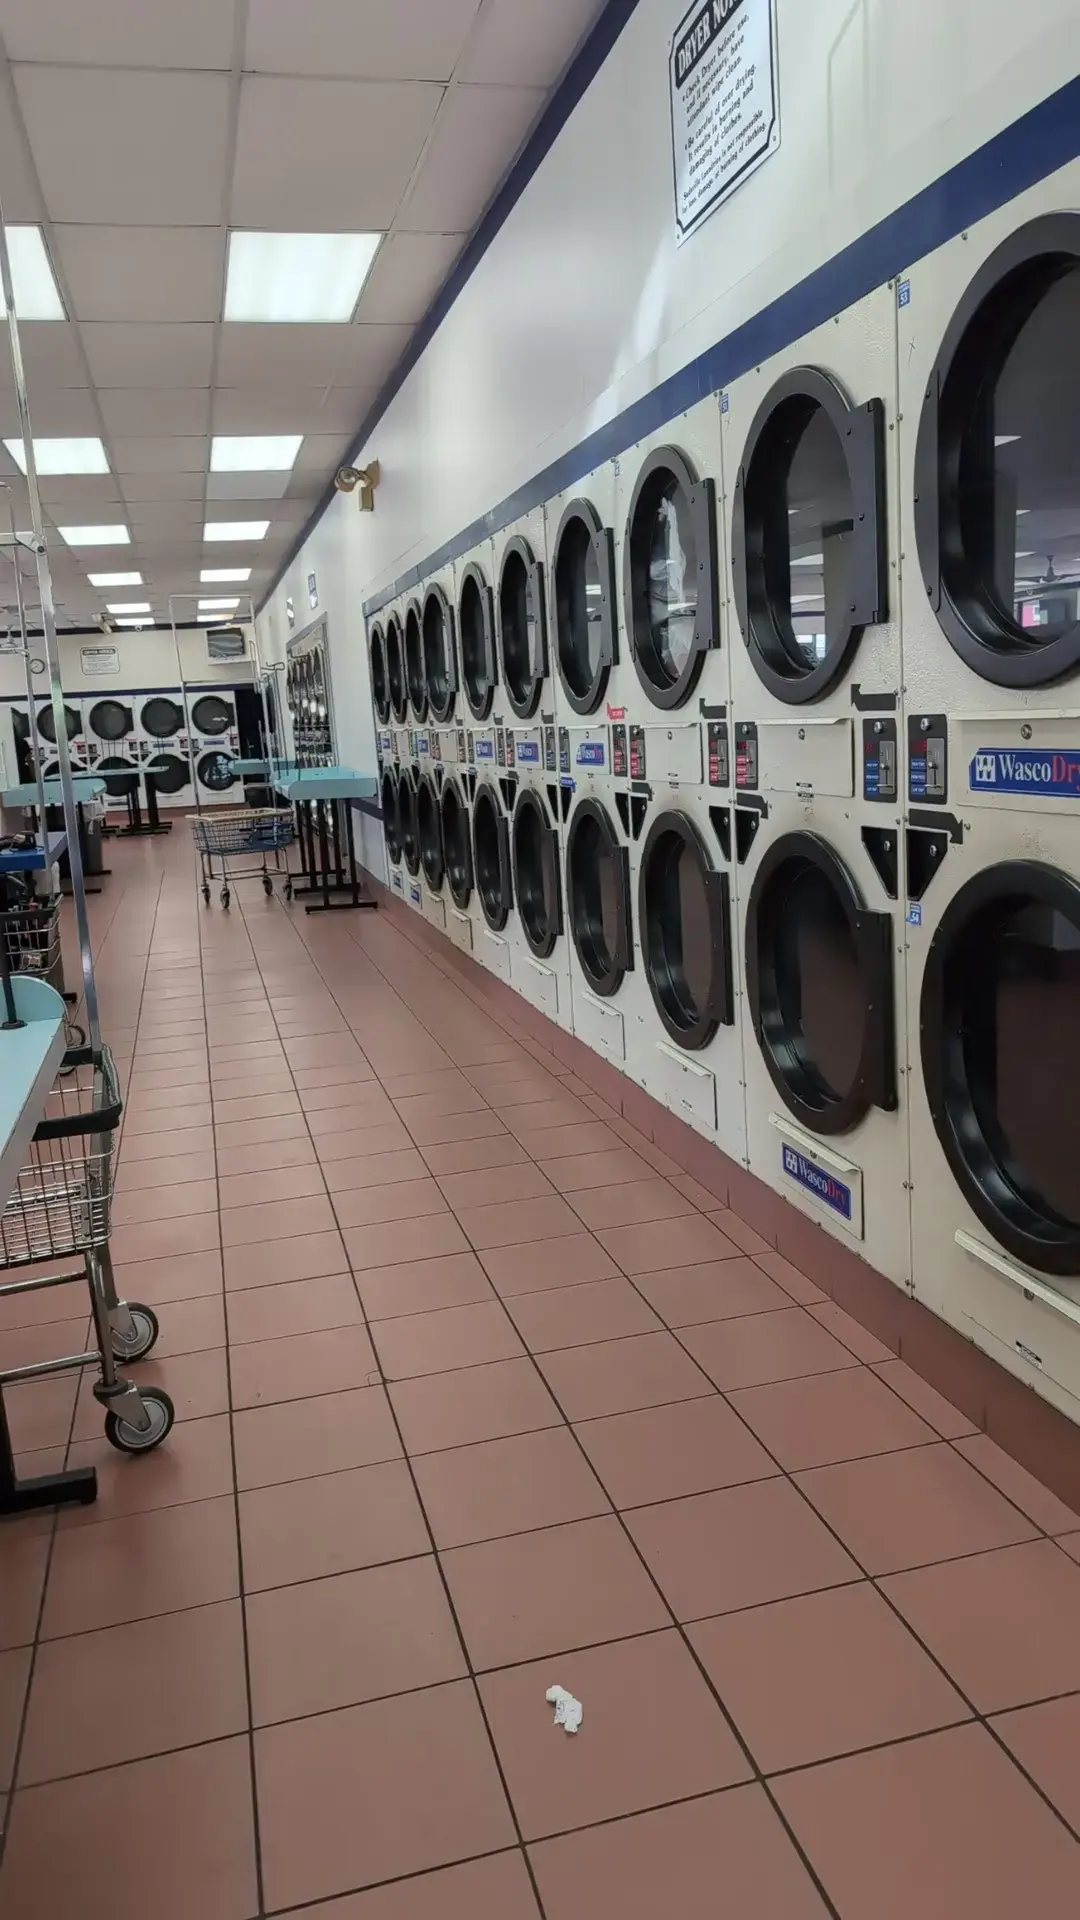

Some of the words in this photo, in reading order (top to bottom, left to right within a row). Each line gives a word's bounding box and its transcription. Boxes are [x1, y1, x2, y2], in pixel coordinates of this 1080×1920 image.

[678, 11, 711, 78] DRYER
[685, 74, 701, 99] Check
[701, 54, 717, 78] Dryer
[717, 30, 736, 56] before
[686, 95, 696, 114] and
[730, 34, 744, 56] have
[686, 93, 711, 128] attendant
[711, 75, 725, 97] wipe
[687, 135, 694, 151] Be
[695, 110, 713, 142] careful
[714, 101, 721, 116] of
[721, 88, 734, 108] over
[693, 131, 711, 157] results
[711, 124, 718, 136] in
[719, 96, 741, 127] burning
[742, 78, 754, 100] and
[689, 145, 713, 177] damaging
[714, 133, 720, 149] of
[727, 138, 735, 153] not
[735, 109, 763, 144] responsible
[719, 151, 738, 174] burning
[738, 143, 744, 155] of
[999, 753, 1080, 792] WascoDr
[798, 1157, 845, 1210] WascoDry
